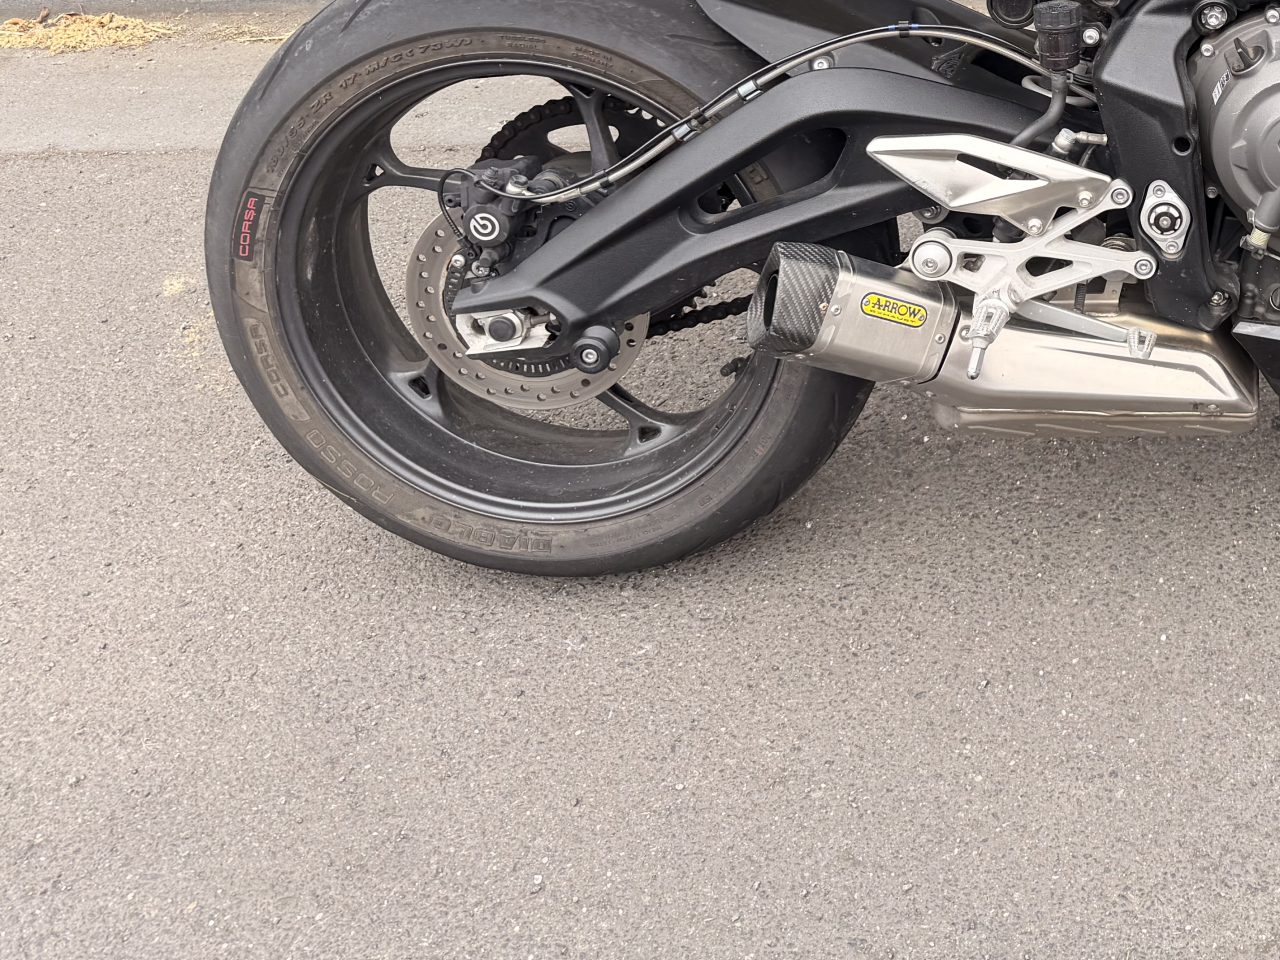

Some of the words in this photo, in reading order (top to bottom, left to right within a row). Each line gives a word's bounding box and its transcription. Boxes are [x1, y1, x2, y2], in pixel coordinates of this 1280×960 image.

[239, 197, 258, 258] CORSA
[871, 297, 921, 319] ARROW
[249, 323, 290, 399] CORSA
[306, 429, 395, 505] ROSSO
